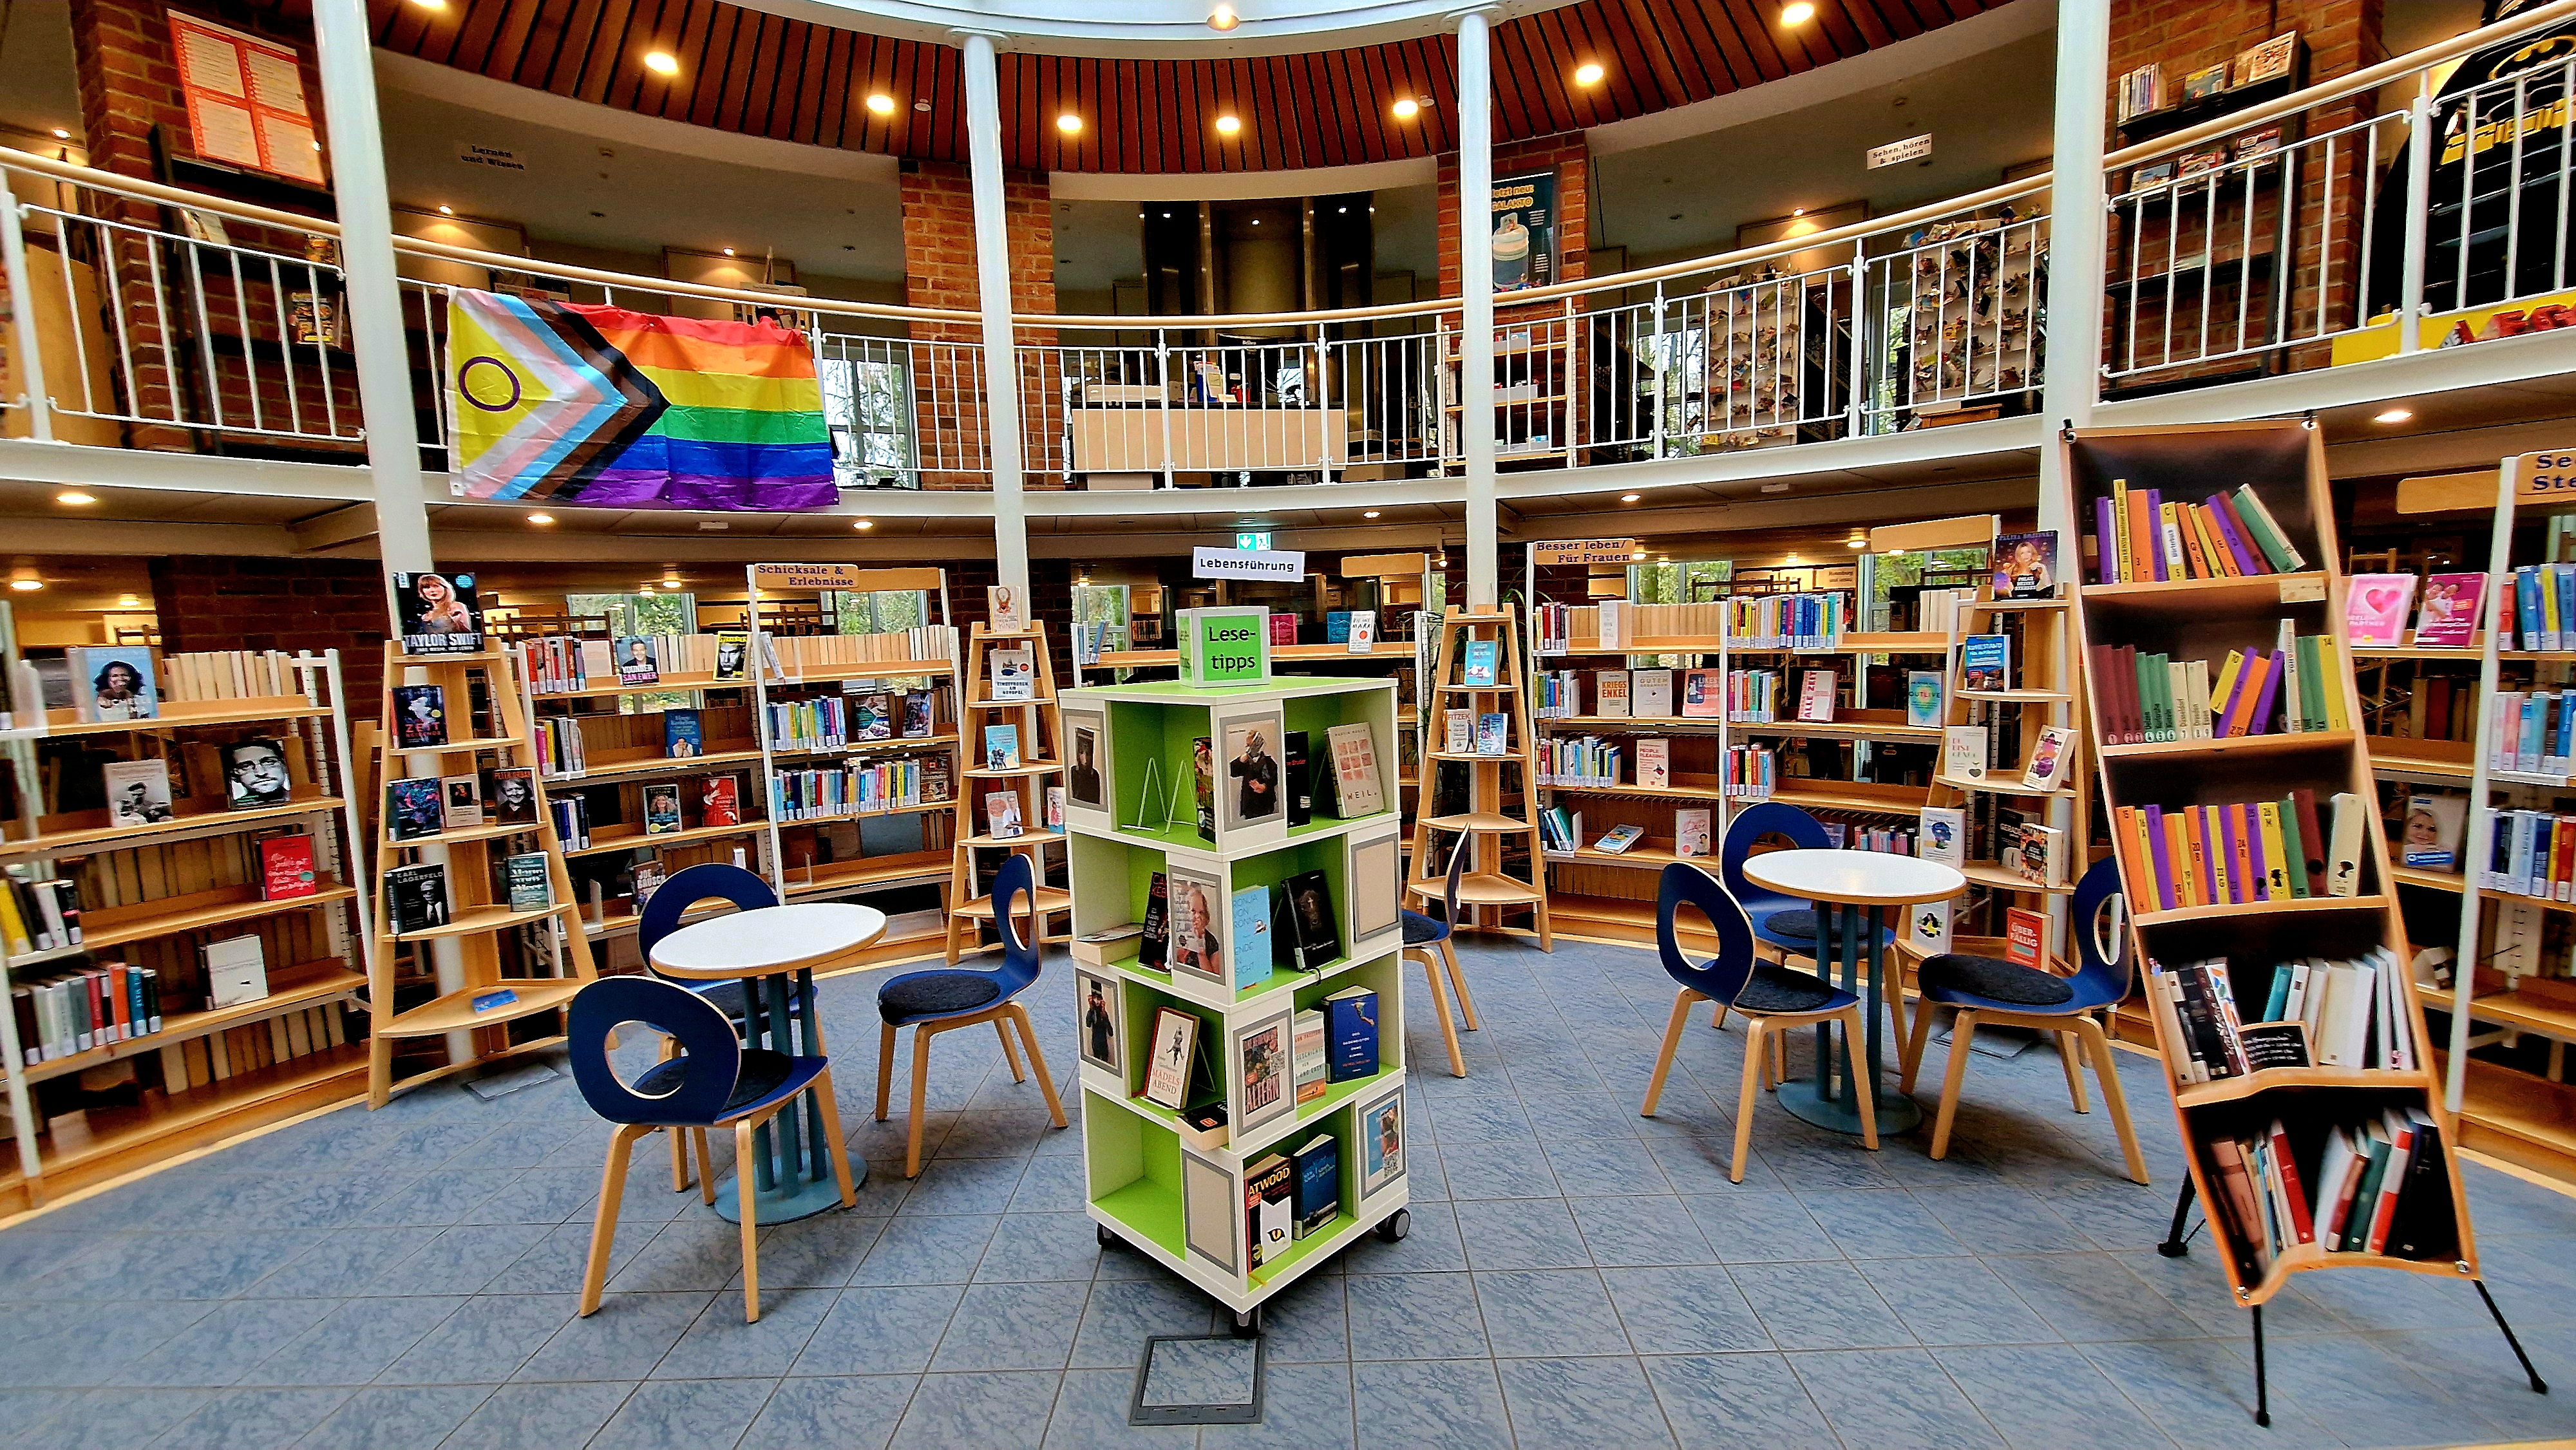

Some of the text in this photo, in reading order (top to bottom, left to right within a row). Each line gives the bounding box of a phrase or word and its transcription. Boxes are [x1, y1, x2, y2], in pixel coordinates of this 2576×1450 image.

[1891, 149, 1924, 162] spielen
[2535, 454, 2576, 469] Se
[1537, 542, 1580, 551] Besser
[1200, 558, 1294, 572] Lebensführung
[1558, 553, 1631, 563] Für Frauen
[759, 565, 843, 575] Schicksale &
[789, 577, 854, 586] Erlebnisse
[404, 633, 482, 648] TAYLOR SWIFT
[1209, 626, 1256, 642] Lese-
[1211, 654, 1256, 673] tipps
[1602, 690, 1627, 698] ENKEL
[1804, 671, 1817, 719] ALLE ZEIT
[2177, 698, 2187, 727] Düsseldorf
[1347, 790, 1378, 800] WEIL.
[397, 872, 444, 883] LAGERFELD
[638, 869, 652, 880] JOE
[1153, 1080, 1177, 1095] ABEND
[1246, 1073, 1279, 1113] ALTERN
[1248, 1167, 1290, 1198] ATWOOD
